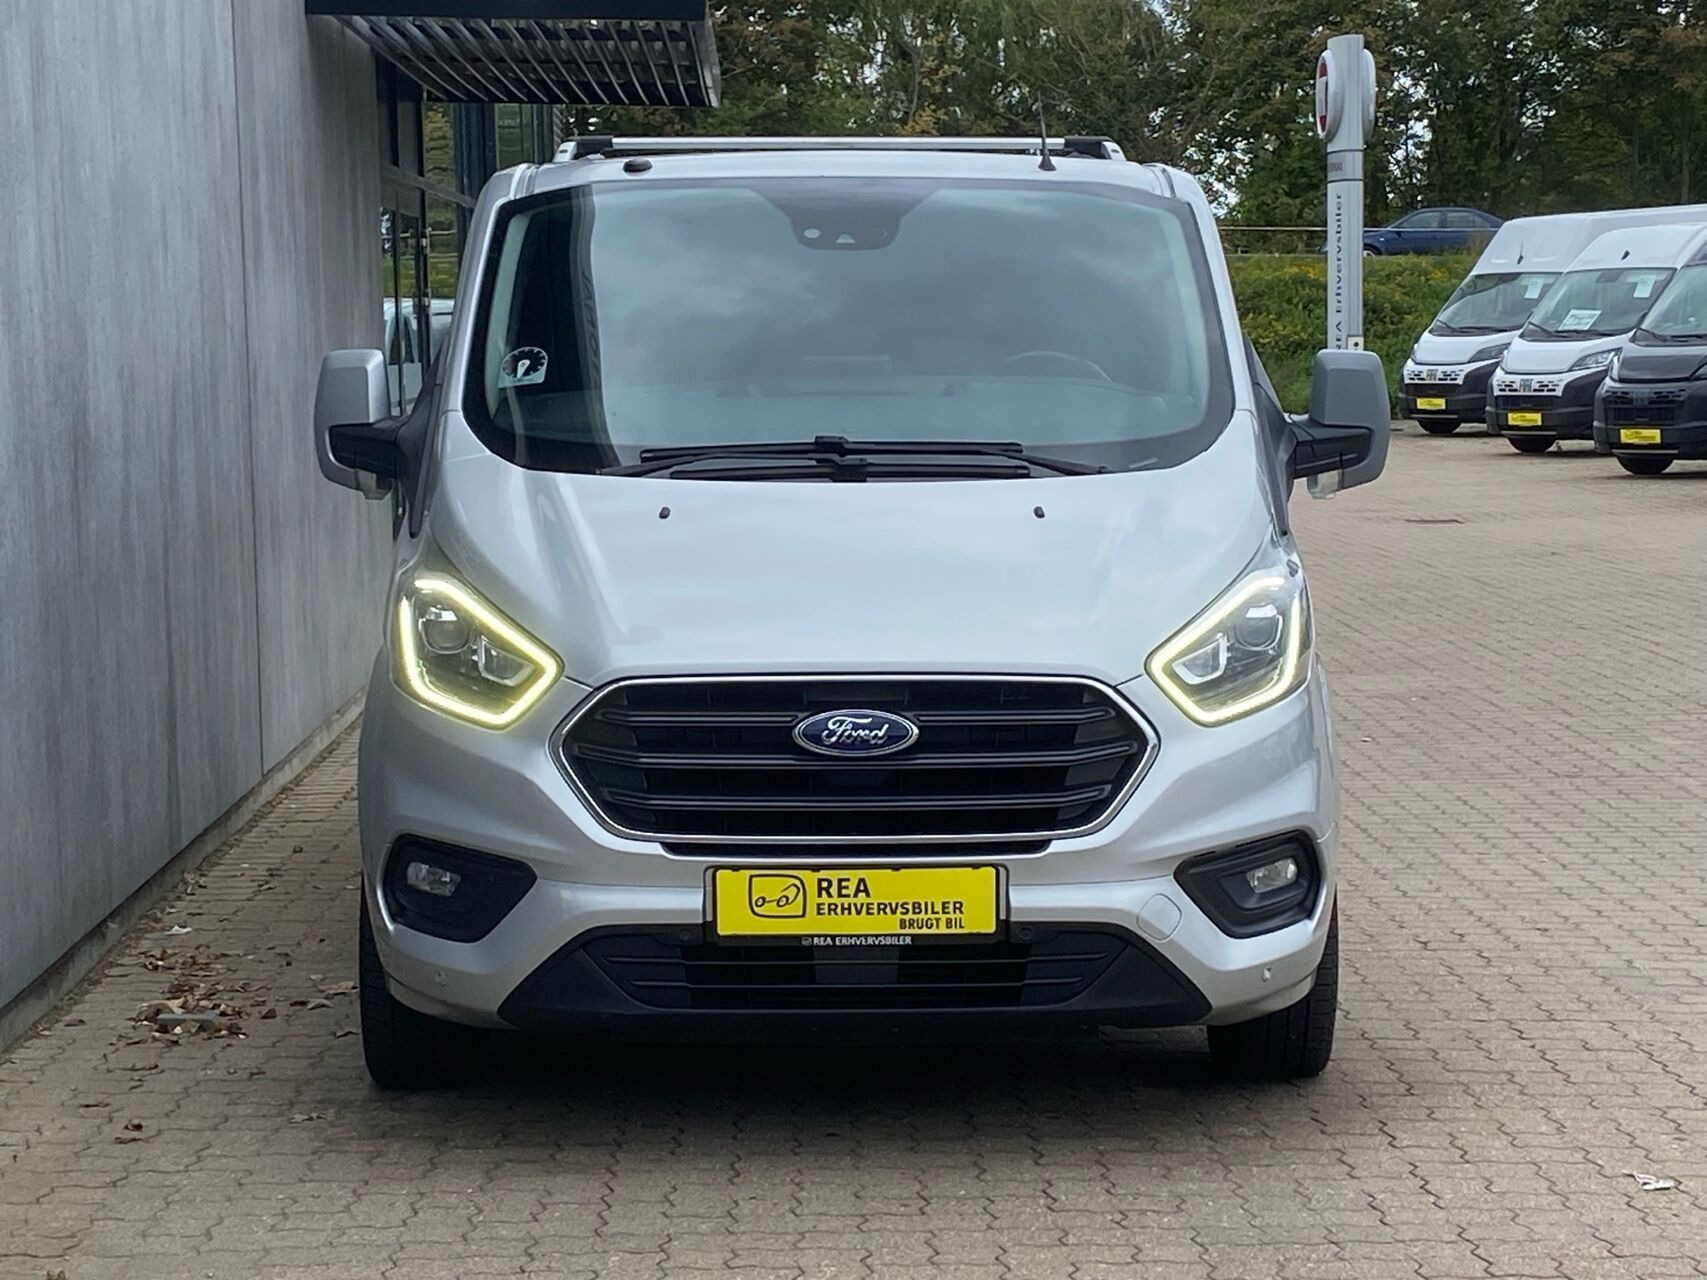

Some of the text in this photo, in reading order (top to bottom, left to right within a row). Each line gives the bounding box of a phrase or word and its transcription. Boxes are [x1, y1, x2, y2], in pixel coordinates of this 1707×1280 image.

[821, 716, 890, 744] Ford
[816, 877, 871, 898] REA
[815, 901, 965, 916] ERHVERVSBILER
[899, 917, 965, 930] BRUGT BIL
[813, 935, 912, 946] REA ERHVERVSBILER
